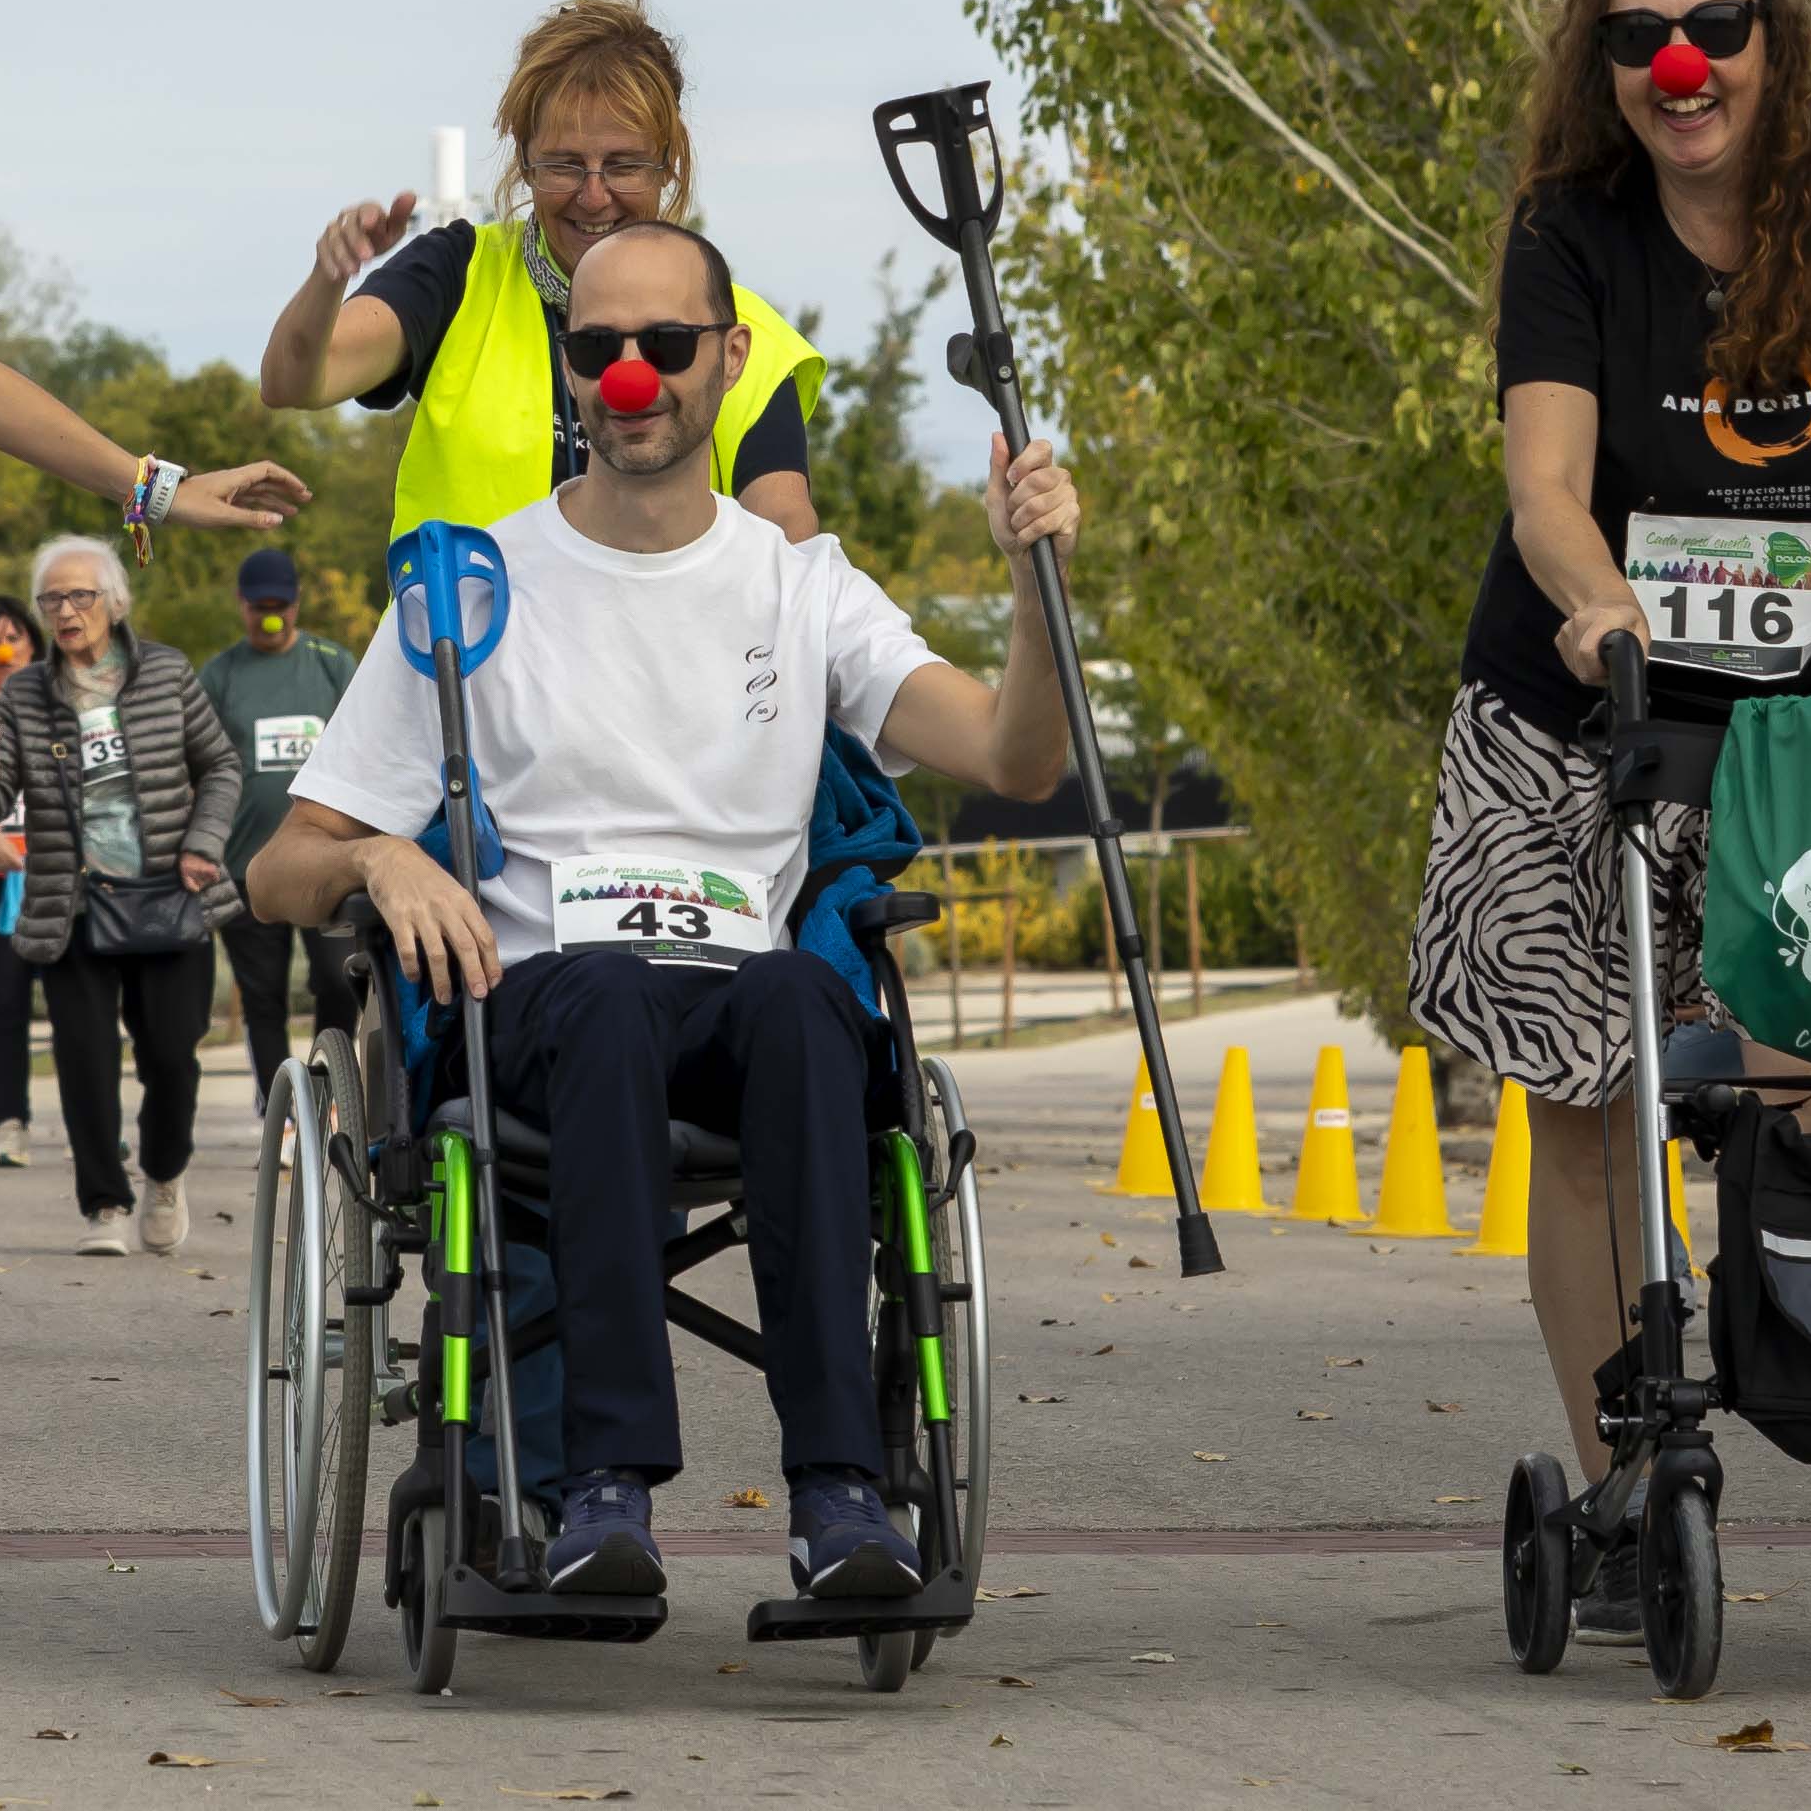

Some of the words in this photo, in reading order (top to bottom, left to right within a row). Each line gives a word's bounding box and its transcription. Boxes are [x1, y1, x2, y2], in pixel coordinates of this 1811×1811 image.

[1661, 393, 1722, 414] ANA
[1745, 493, 1811, 503] PACIENTES
[1775, 554, 1811, 565] DOLOR
[1659, 585, 1794, 646] 116
[271, 739, 313, 758] 140
[617, 901, 712, 940] 43
